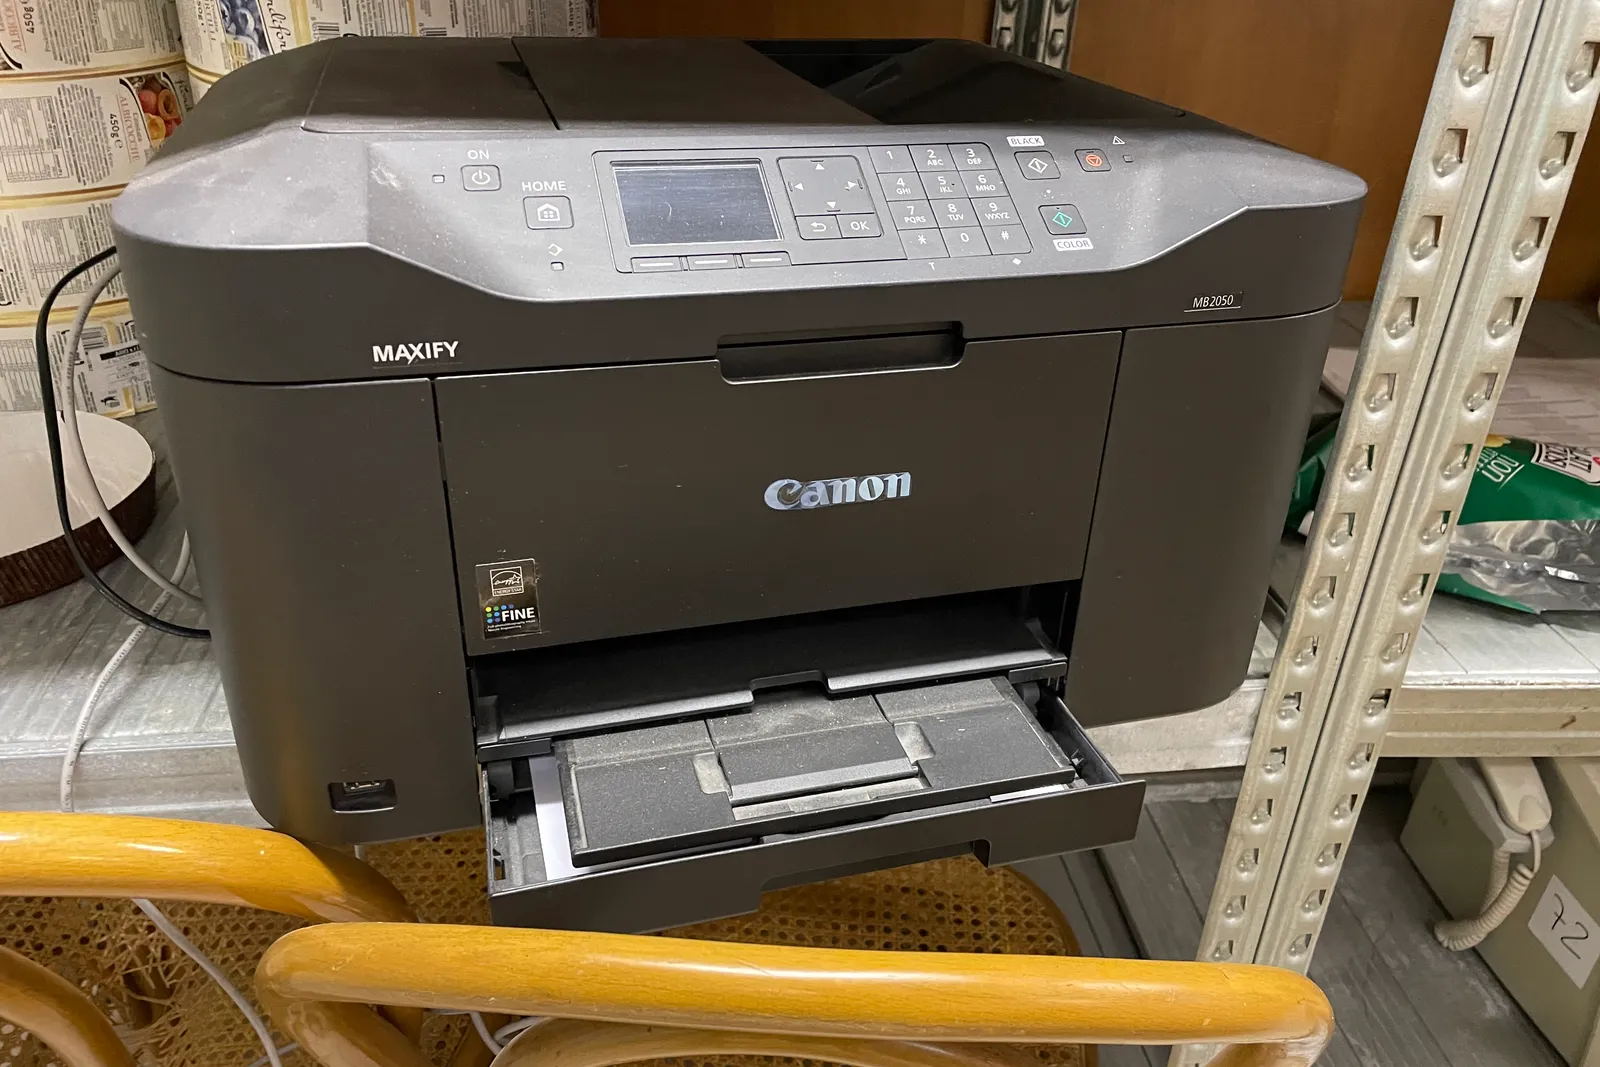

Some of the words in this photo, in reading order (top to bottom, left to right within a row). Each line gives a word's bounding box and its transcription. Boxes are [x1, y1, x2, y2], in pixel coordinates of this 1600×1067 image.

[23, 6, 35, 34] 450g
[110, 113, 120, 138] 450g
[1010, 137, 1042, 145] BLACK
[467, 149, 490, 160] ON
[886, 150, 894, 160] 1
[926, 149, 936, 159] 2
[966, 148, 975, 158] 3
[896, 177, 906, 187] 4
[938, 176, 946, 185] 5
[978, 174, 987, 184] 6
[521, 180, 567, 192] HOME
[906, 205, 915, 215] 7
[947, 203, 957, 213] 8
[988, 202, 998, 212] 9
[904, 215, 926, 224] PQRS
[947, 213, 964, 221] TUV
[985, 212, 1010, 220] WXYZ
[849, 220, 871, 232] OK
[960, 232, 970, 243] 0
[1057, 239, 1091, 248] COLOR
[1192, 294, 1234, 309] MB2050
[372, 340, 459, 365] MAXIFY
[763, 471, 912, 511] Canon
[501, 607, 535, 622] FINE
